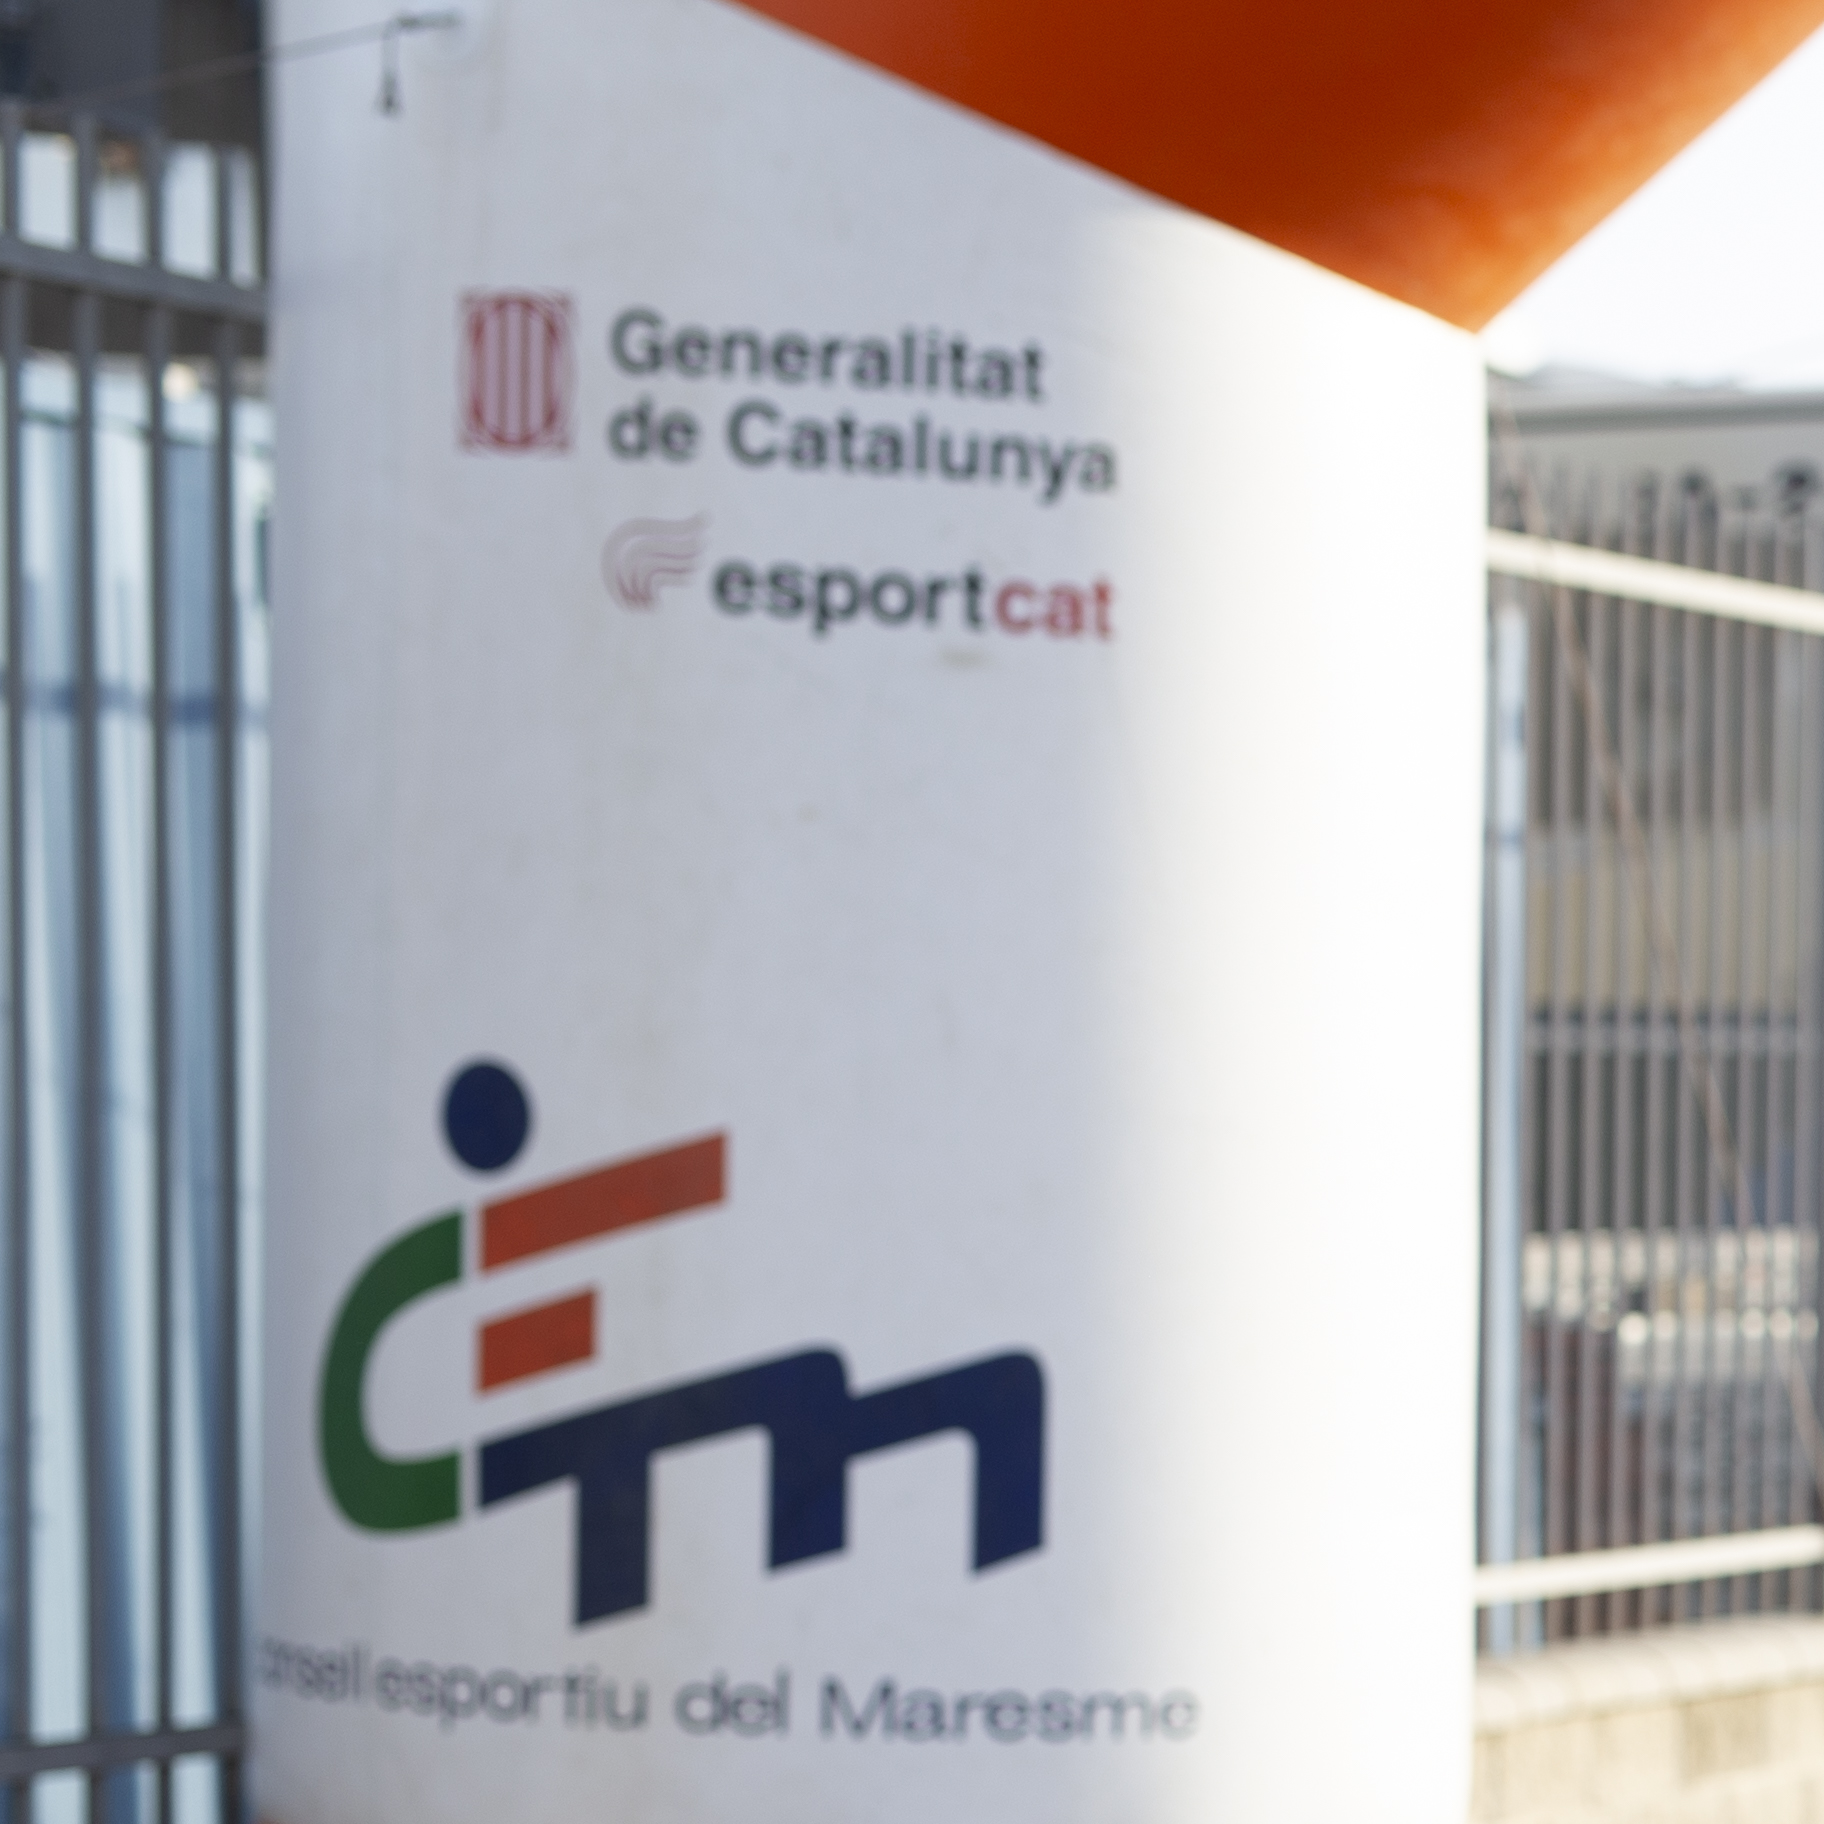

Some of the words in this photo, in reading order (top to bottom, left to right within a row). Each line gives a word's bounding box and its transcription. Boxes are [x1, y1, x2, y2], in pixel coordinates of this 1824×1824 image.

[611, 308, 1047, 402] Generalitat
[609, 400, 700, 463] de
[726, 401, 1118, 506] Catalunya
[714, 560, 1114, 640] esportcat
[374, 1656, 650, 1734] esportiu
[674, 1666, 790, 1740] del
[820, 1674, 1202, 1744] Maresme
